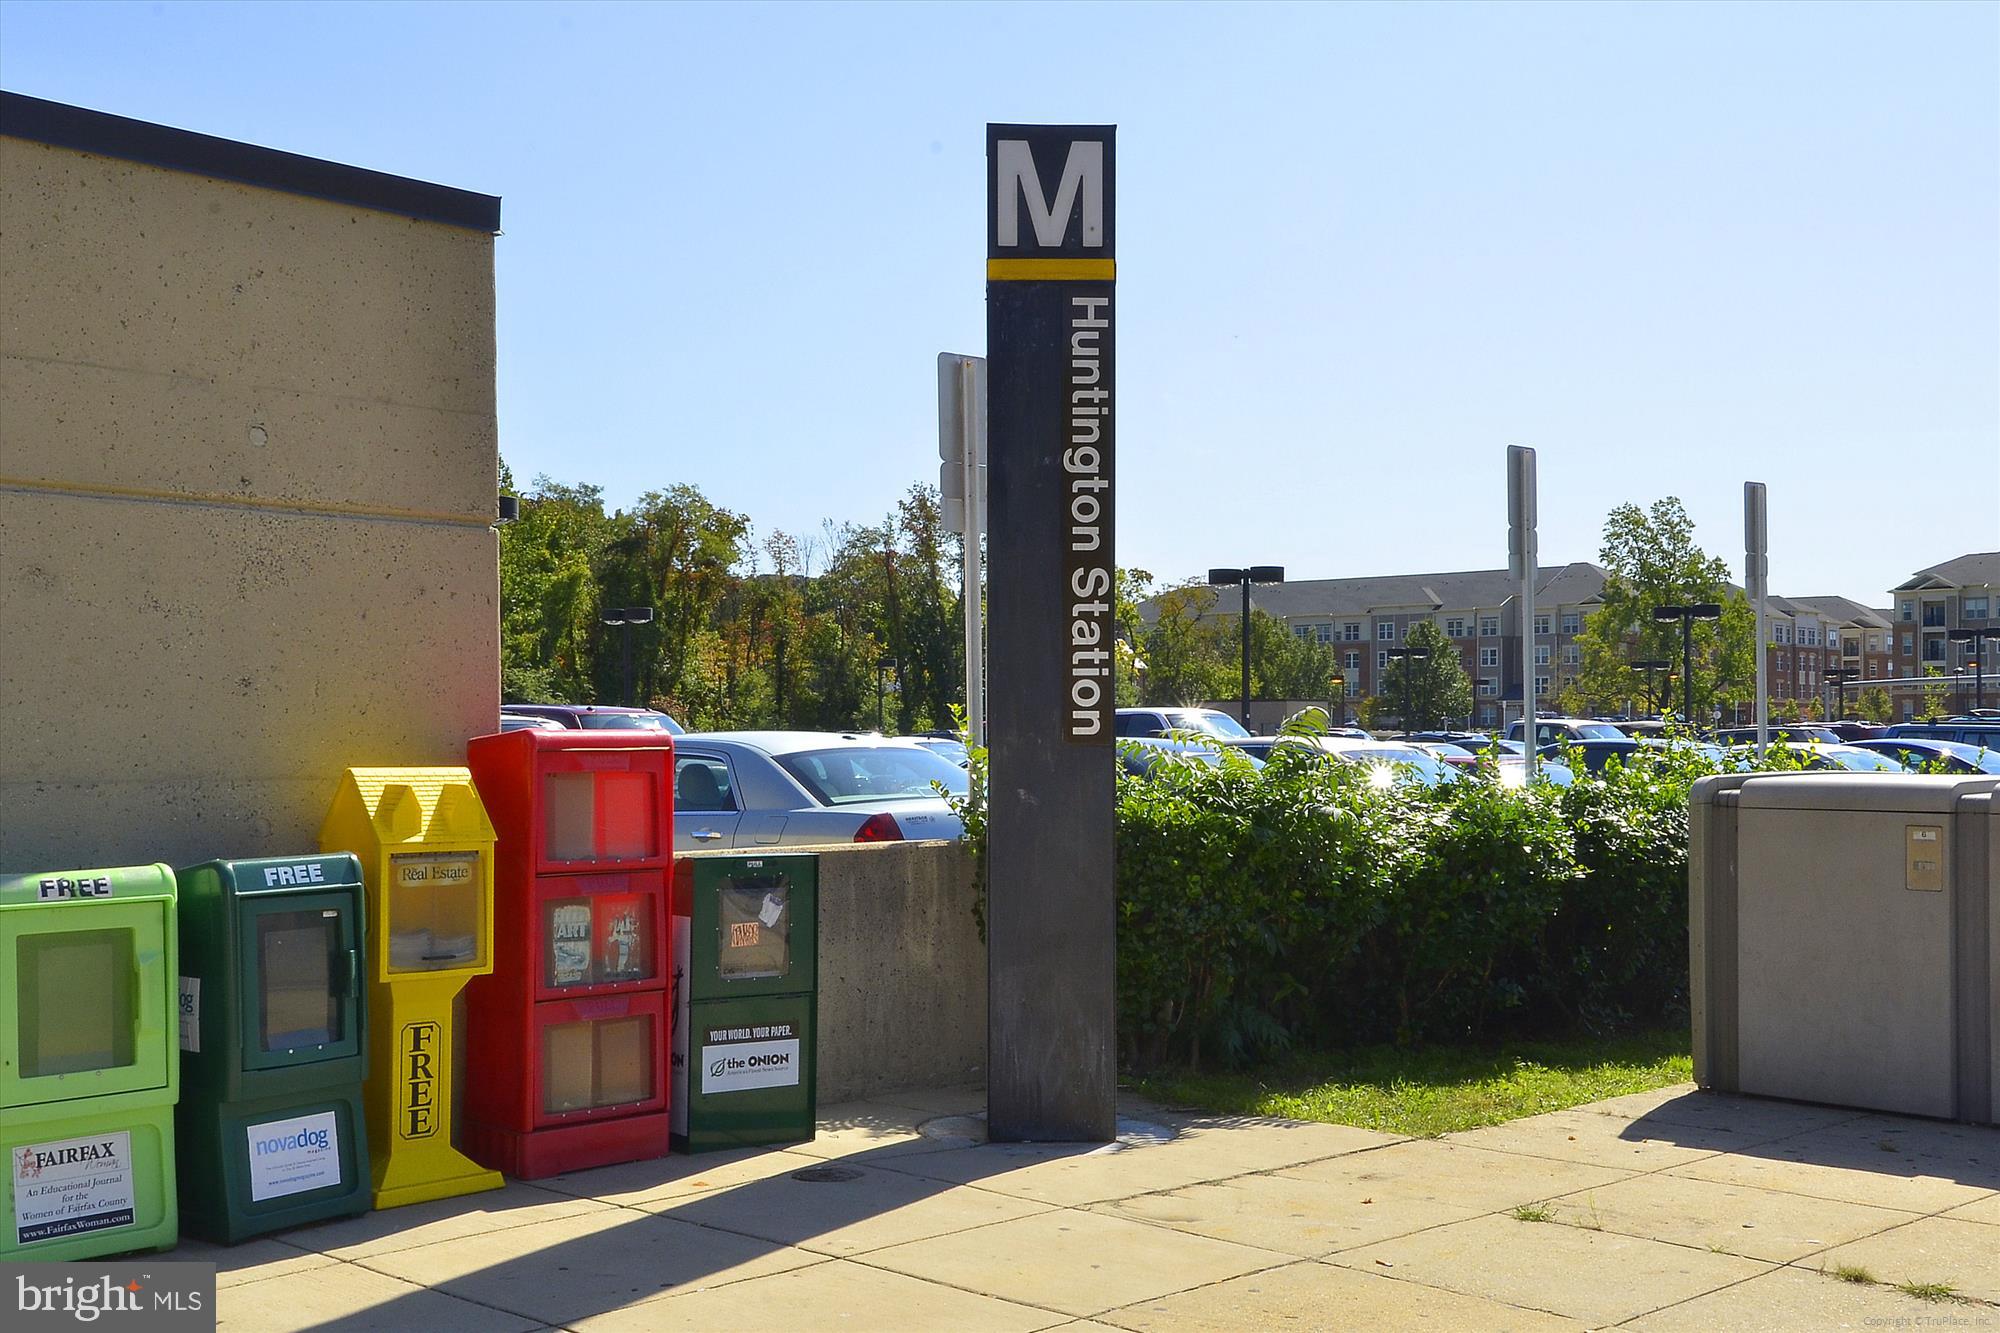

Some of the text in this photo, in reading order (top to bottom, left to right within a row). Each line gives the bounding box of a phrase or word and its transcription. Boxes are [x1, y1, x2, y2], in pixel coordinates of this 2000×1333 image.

[998, 140, 1103, 247] M
[1063, 297, 1109, 736] Huntington Station
[264, 864, 325, 887] FREE
[402, 866, 469, 881] Real Estate
[40, 877, 109, 898] FREE
[709, 1025, 792, 1042] YOUR WORLD. YOUR PAPER.
[727, 1054, 789, 1069] the ONION
[407, 1025, 434, 1136] FREE
[256, 1128, 329, 1156] novadog
[36, 1142, 115, 1168] FAIRFAX
[26, 1174, 122, 1198] An Educational Journal
[62, 1192, 88, 1203] for the
[22, 1197, 128, 1221] Women of Fairfax County
[22, 1215, 130, 1239] www.FairfaxWoman.com
